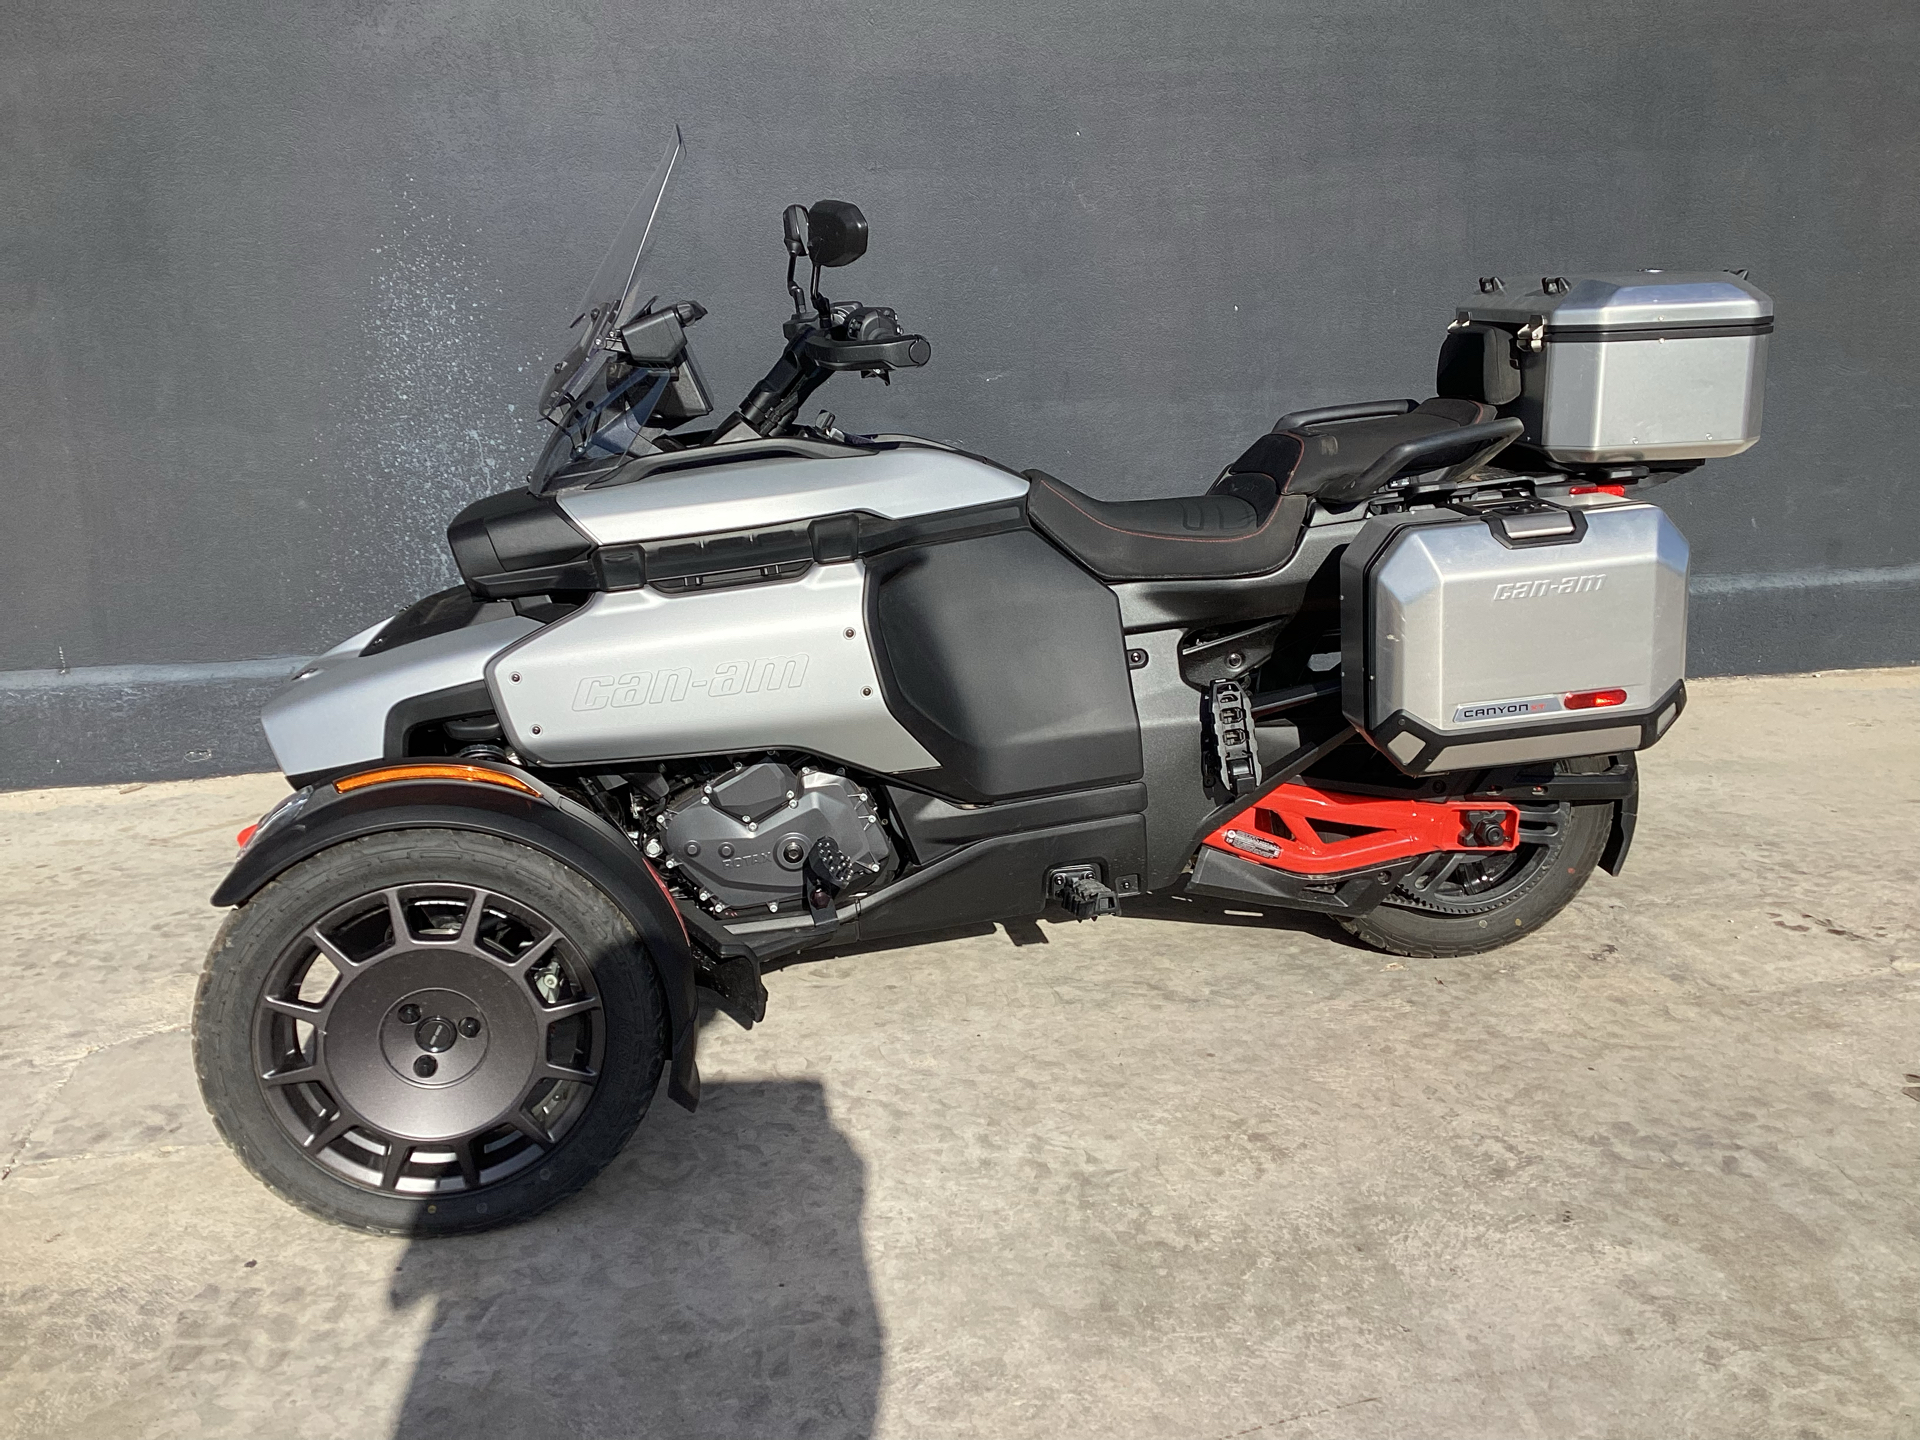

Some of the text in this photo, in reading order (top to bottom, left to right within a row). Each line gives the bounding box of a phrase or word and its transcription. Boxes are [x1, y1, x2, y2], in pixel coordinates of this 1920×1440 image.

[1493, 573, 1607, 602] can-am
[571, 653, 810, 712] can-am
[1463, 703, 1529, 718] CANYON
